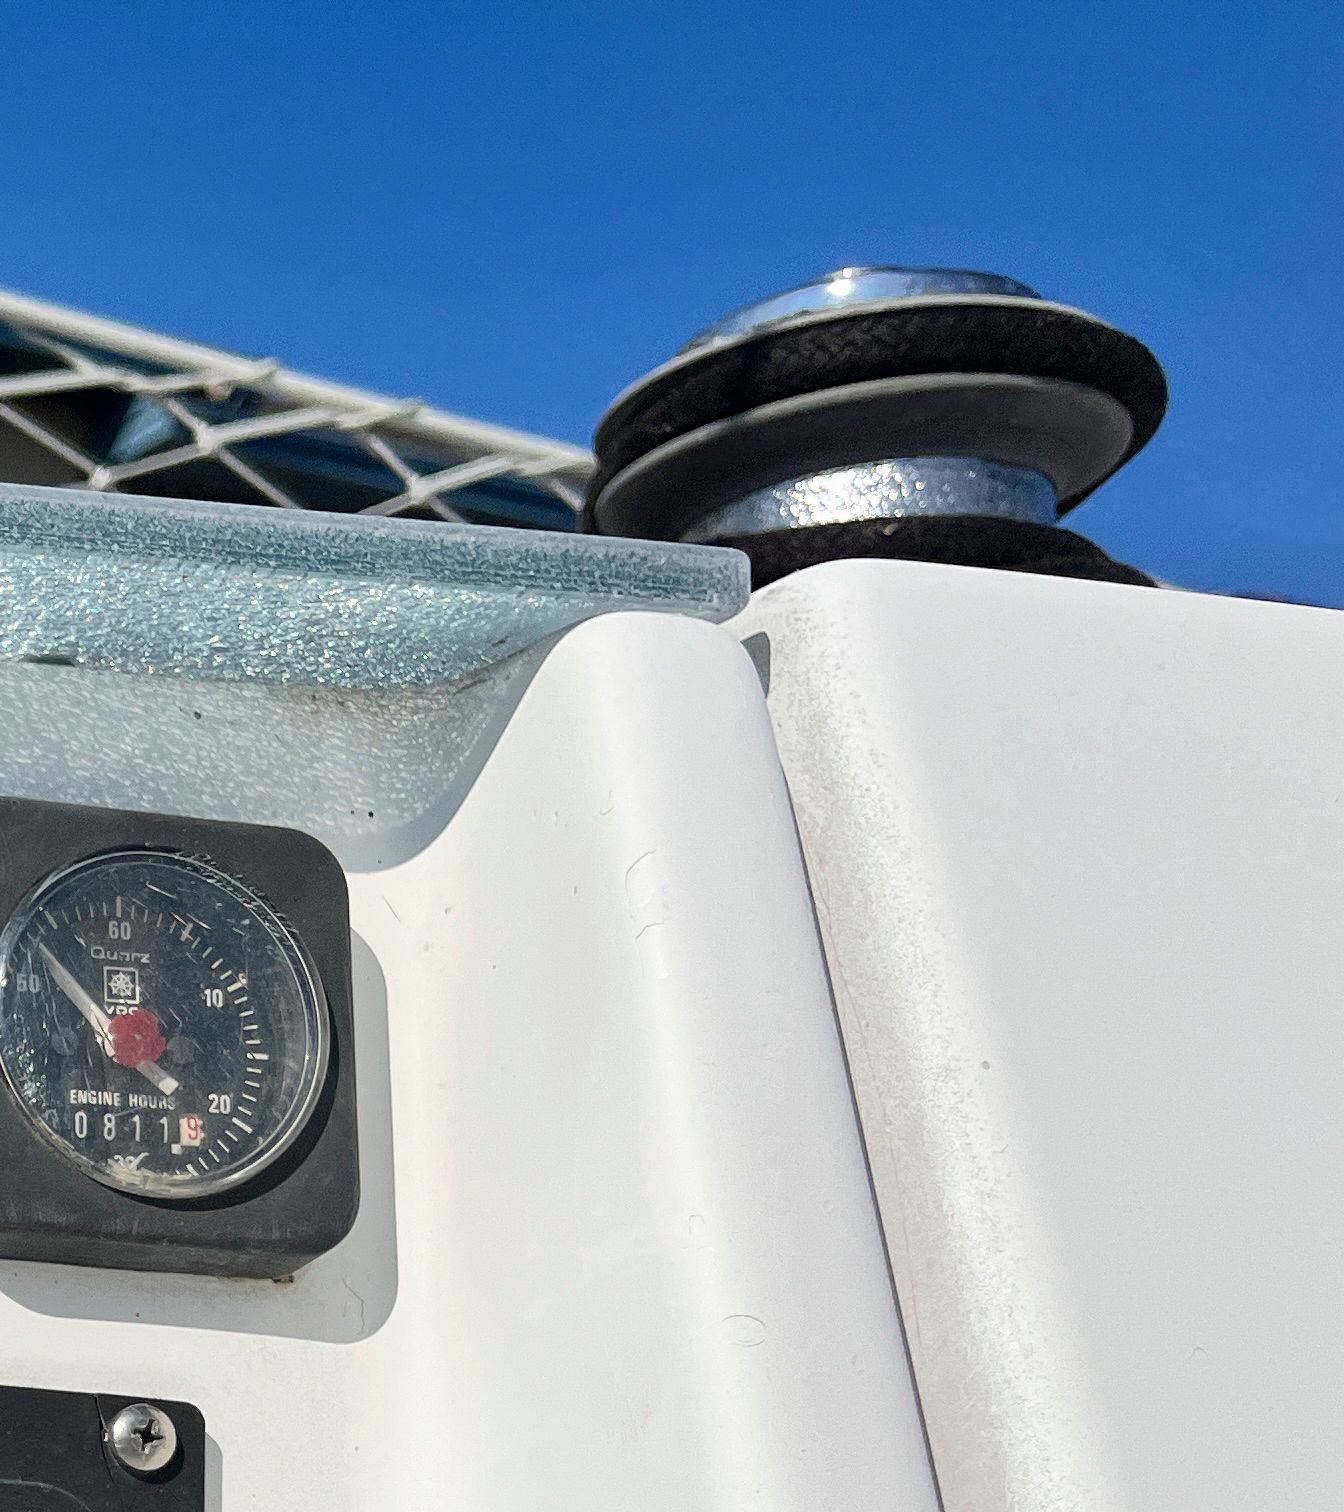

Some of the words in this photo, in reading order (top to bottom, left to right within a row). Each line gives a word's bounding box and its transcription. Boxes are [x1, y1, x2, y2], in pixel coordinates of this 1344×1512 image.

[108, 919, 132, 941] 60
[205, 988, 224, 1009] 10
[69, 1089, 121, 1108] ENGINE
[128, 1093, 176, 1111] HOURS
[208, 1093, 231, 1115] 20
